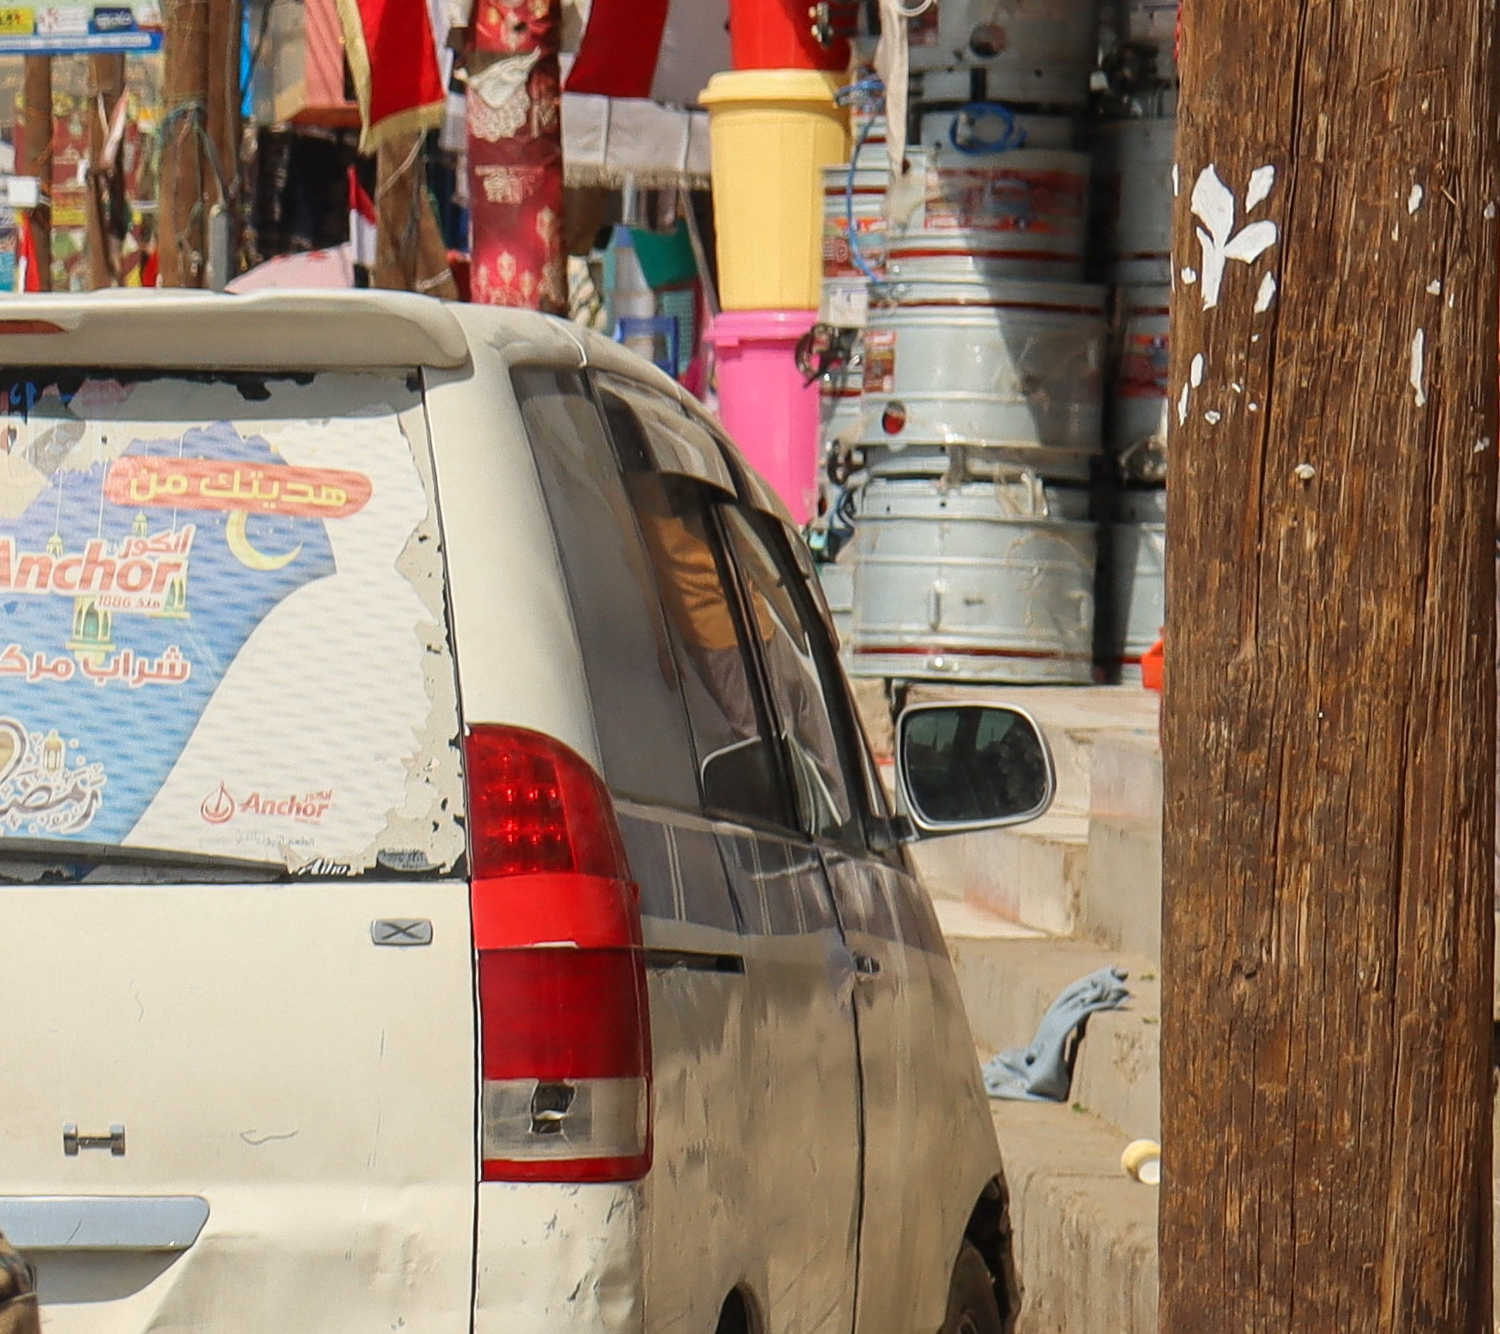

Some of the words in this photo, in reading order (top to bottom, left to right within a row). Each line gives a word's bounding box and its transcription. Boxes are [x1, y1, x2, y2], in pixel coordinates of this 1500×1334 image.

[129, 469, 189, 502] من
[200, 468, 348, 508] هديتك
[83, 647, 190, 685] شراب
[240, 791, 331, 818] Anchor
